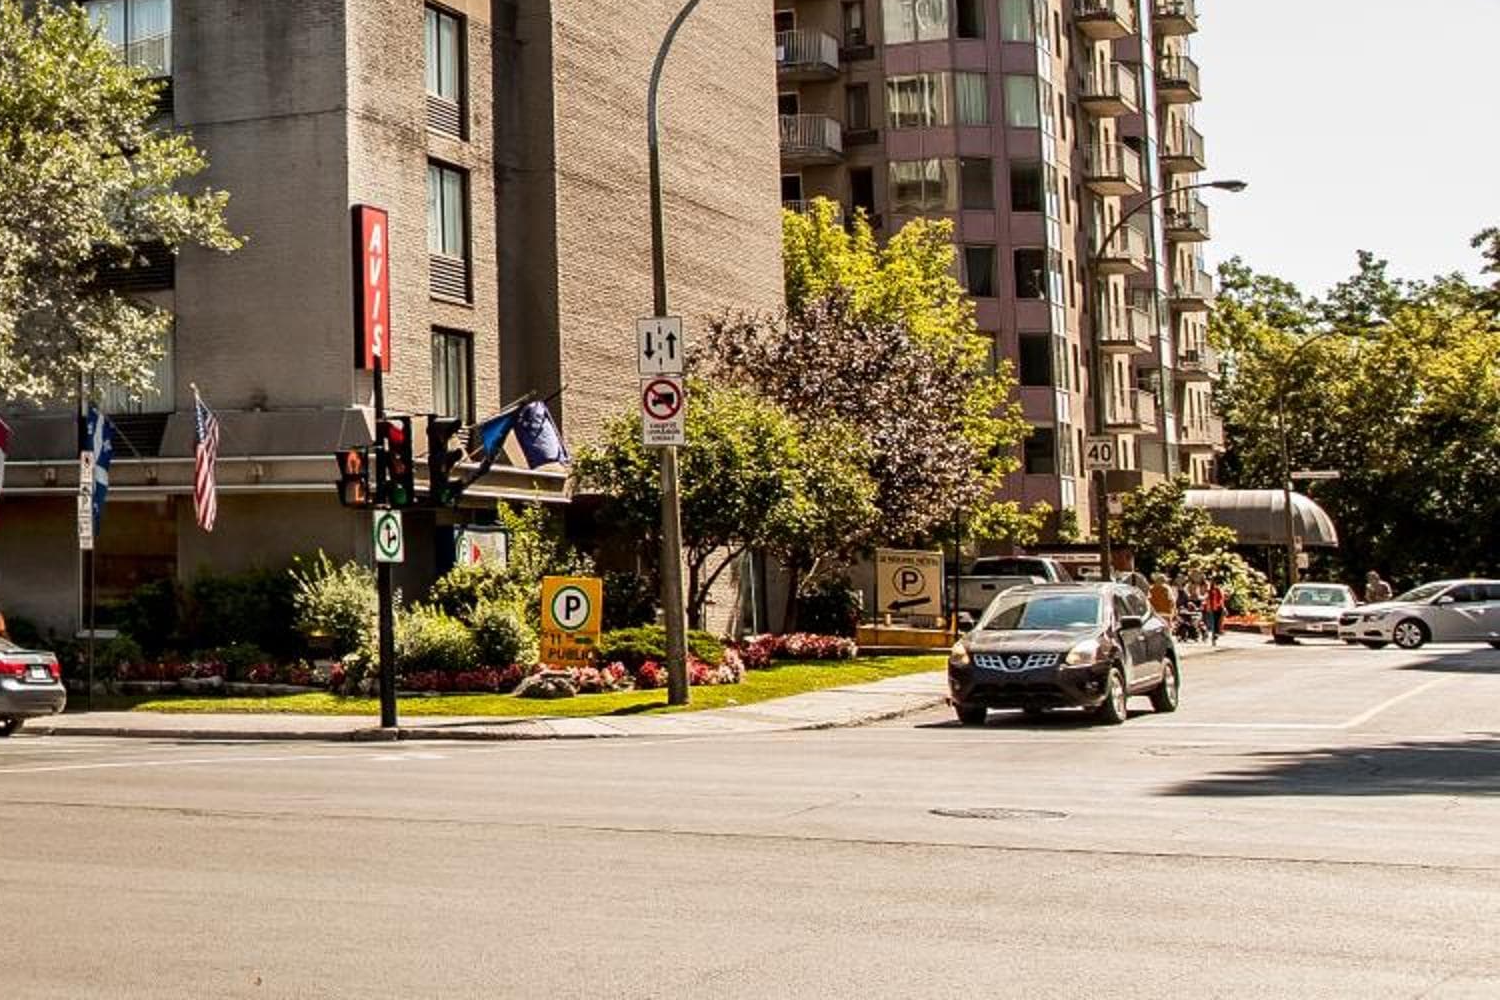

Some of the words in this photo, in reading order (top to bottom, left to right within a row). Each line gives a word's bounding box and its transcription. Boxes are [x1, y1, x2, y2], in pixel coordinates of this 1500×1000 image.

[369, 222, 383, 357] AVIS
[1088, 444, 1111, 462] 40
[902, 571, 918, 591] P
[565, 595, 581, 620] P
